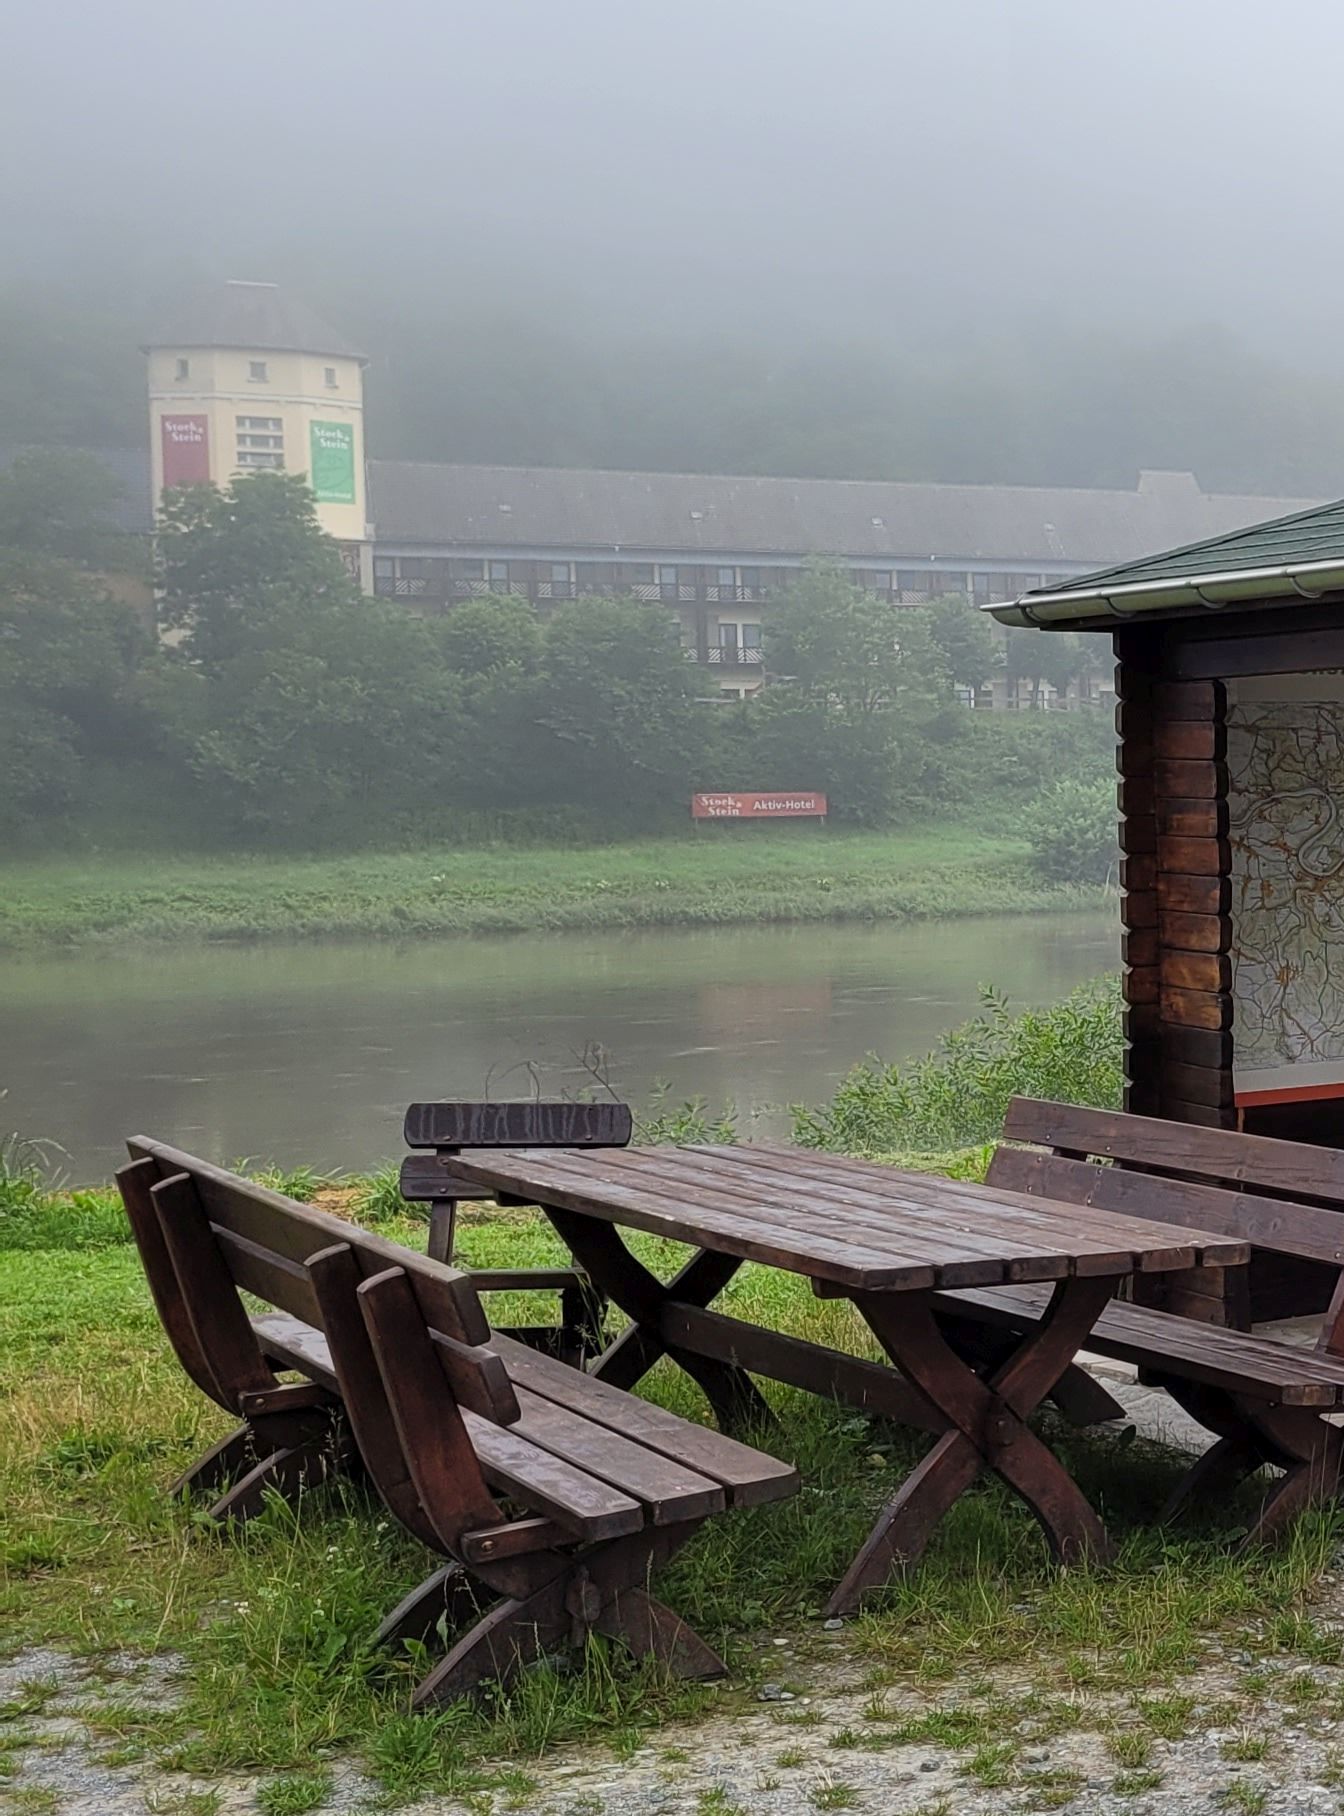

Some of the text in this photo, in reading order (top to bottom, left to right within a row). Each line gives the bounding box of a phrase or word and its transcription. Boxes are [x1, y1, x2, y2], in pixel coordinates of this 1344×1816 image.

[701, 796, 736, 807] Stock
[753, 799, 815, 811] Aktiv-Hotel
[707, 806, 740, 816] Stein
